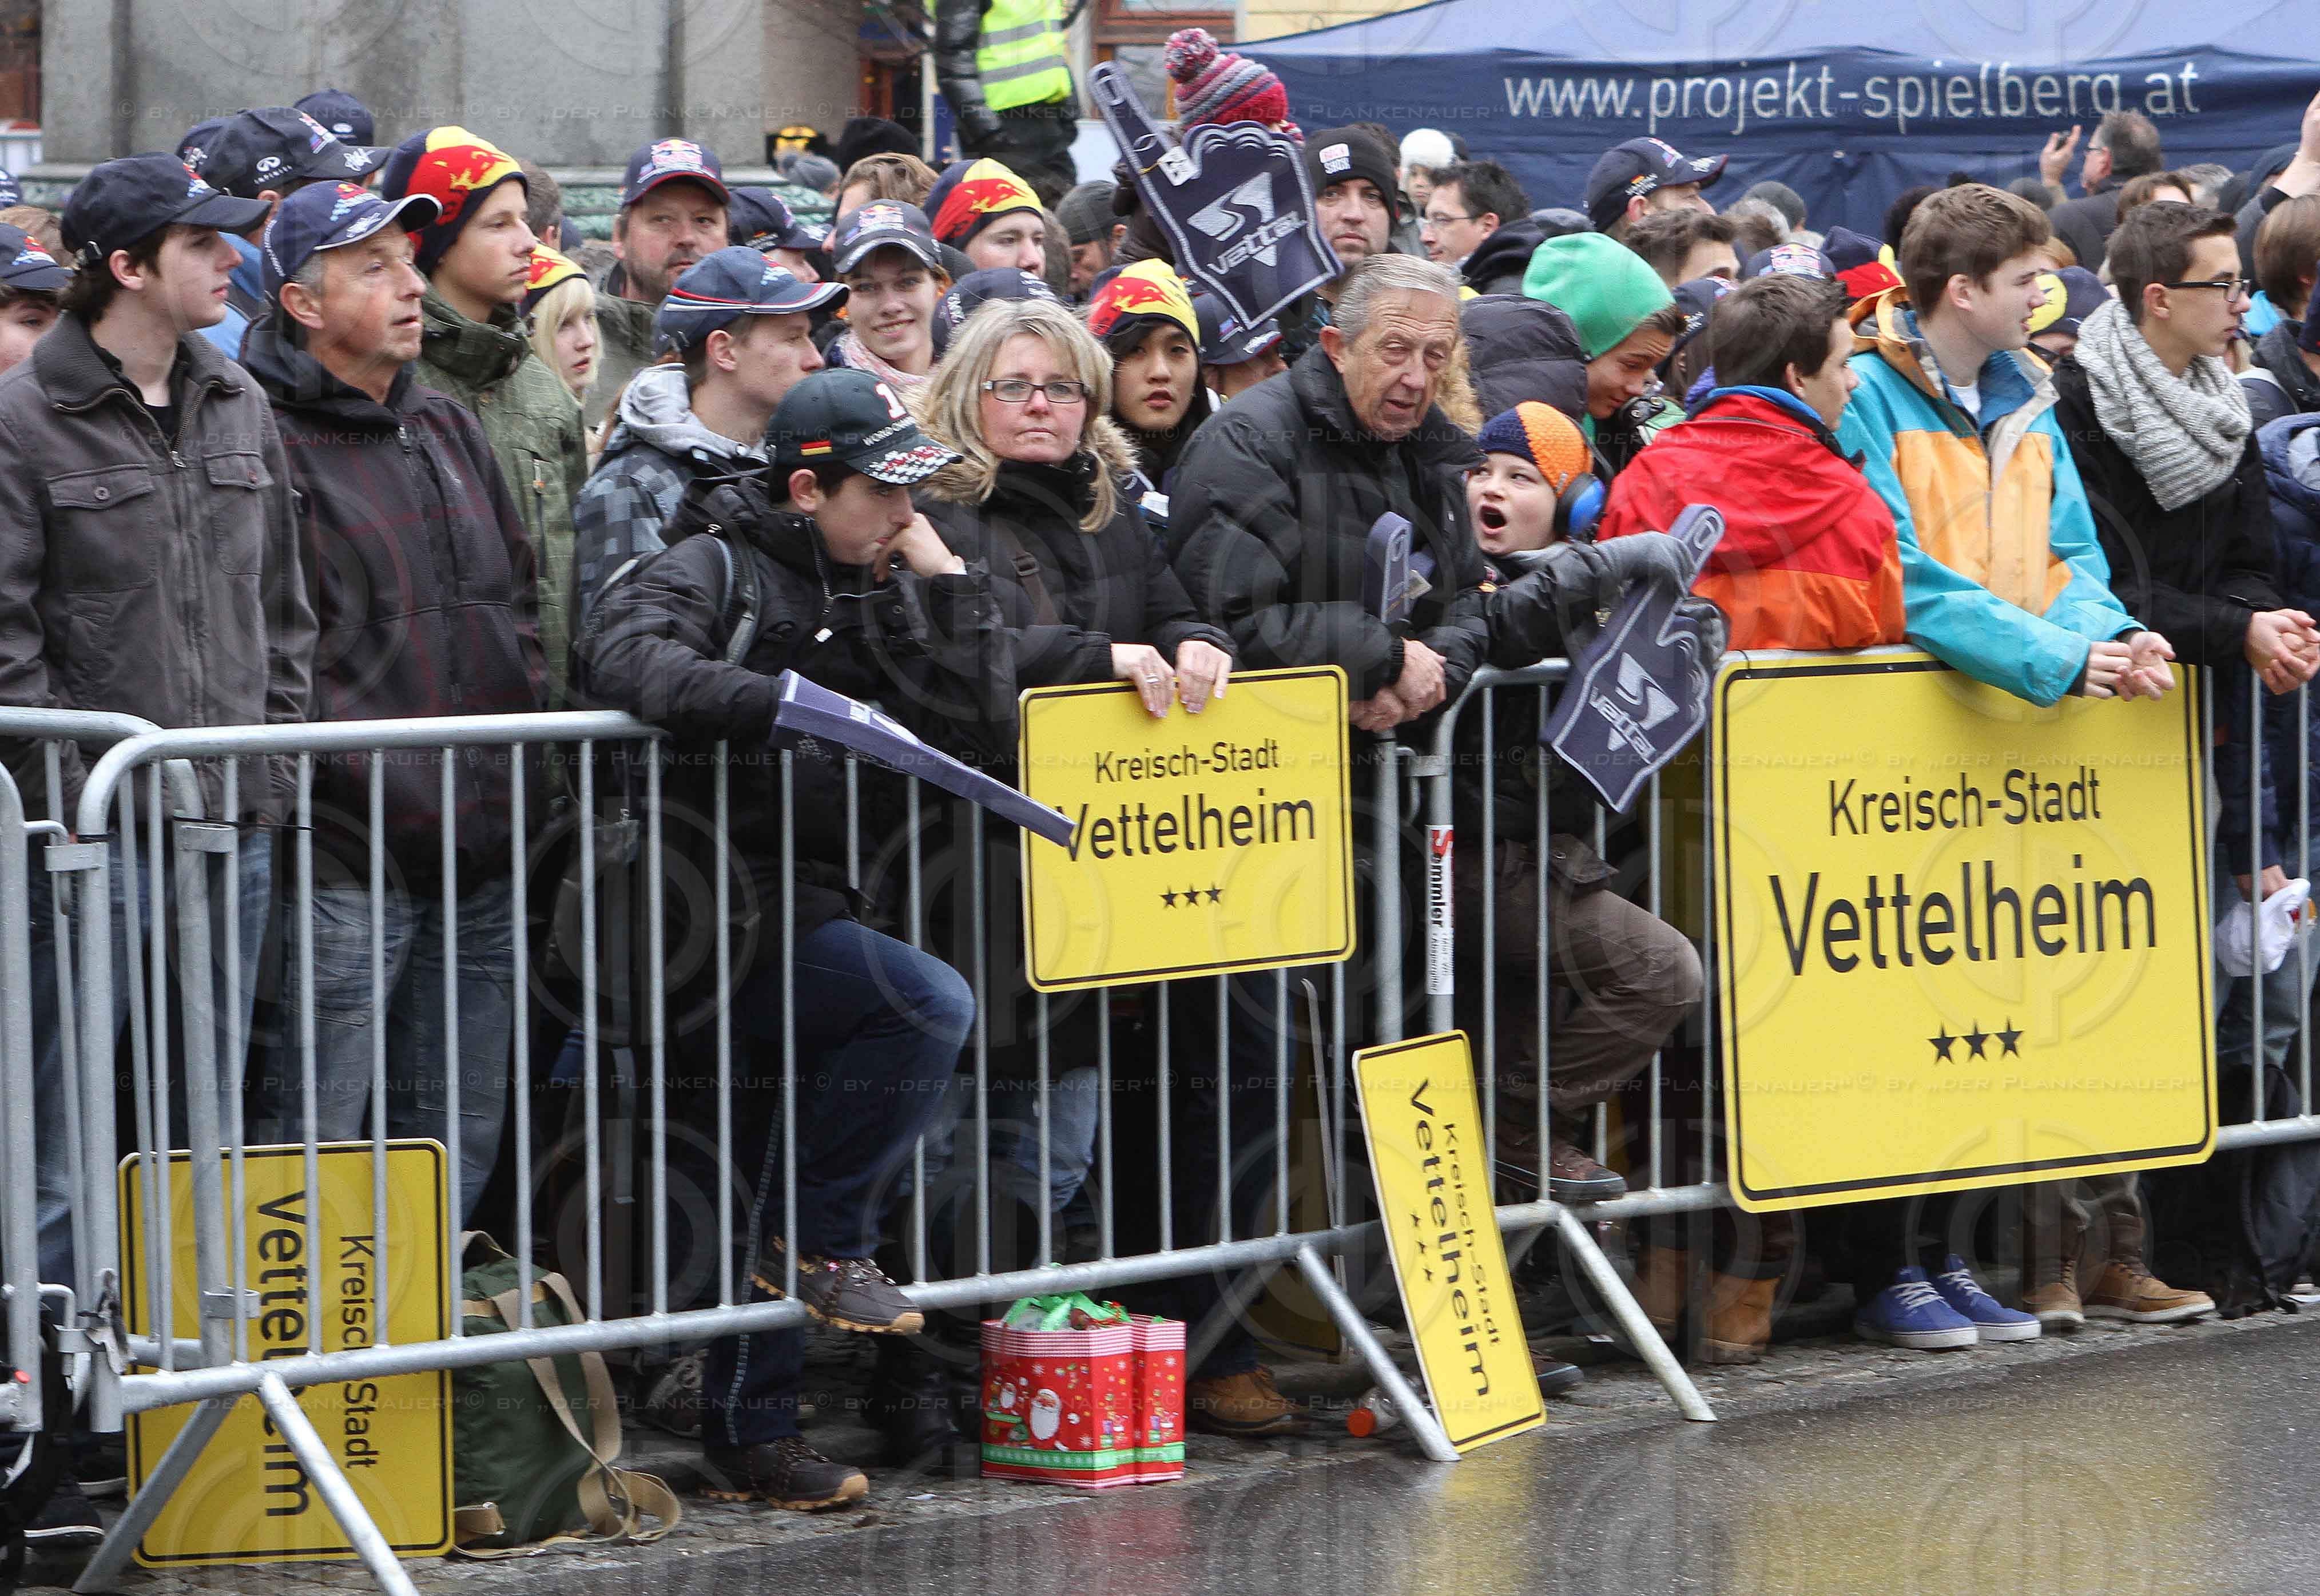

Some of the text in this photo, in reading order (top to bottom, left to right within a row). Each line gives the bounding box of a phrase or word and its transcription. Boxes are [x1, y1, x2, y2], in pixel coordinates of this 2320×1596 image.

[1504, 59, 2200, 136] www.projekt-spielberg.at
[875, 382, 909, 420] 1
[1095, 737, 1280, 783] Kreisch-Stadt
[1055, 787, 1316, 861] Vettelheim
[1829, 766, 2101, 836] Kreisch-Stadt
[1769, 854, 2156, 976] Vettelheim
[1410, 1078, 1490, 1396] Vettelheim
[1443, 1122, 1502, 1345] Kreisch-Stadt
[340, 1235, 379, 1469] KreiscStadt
